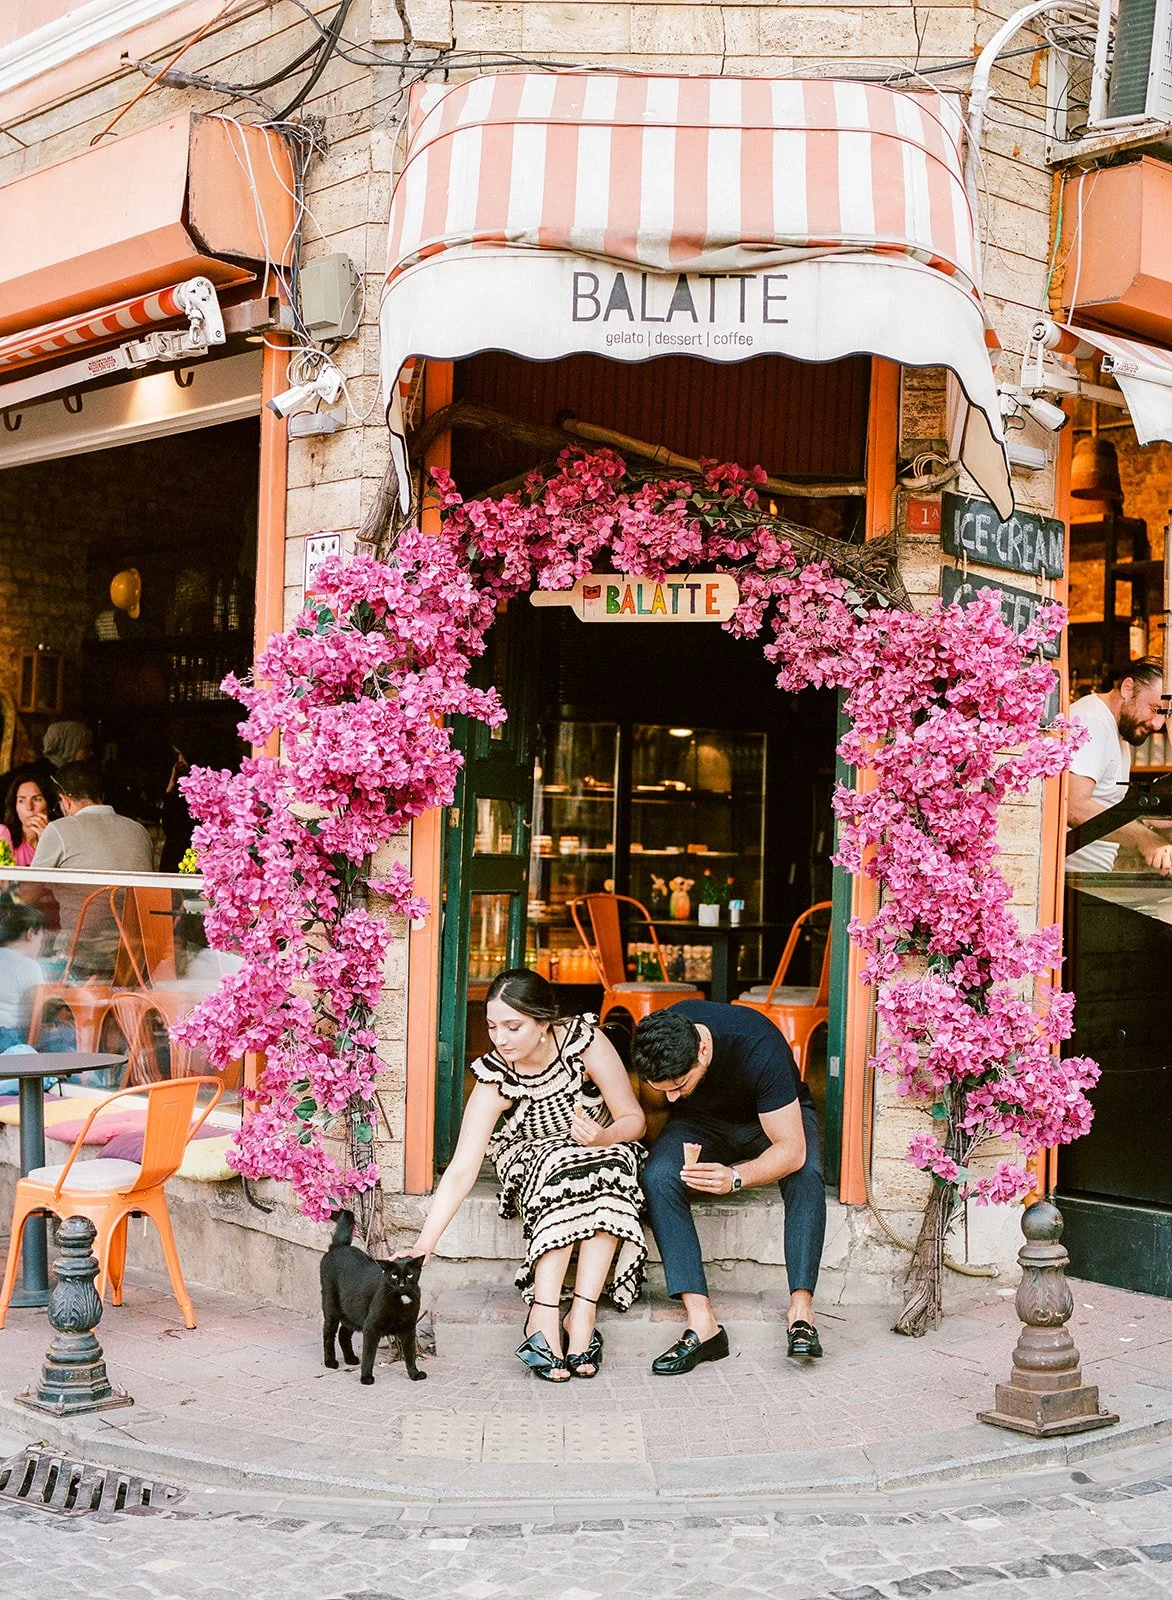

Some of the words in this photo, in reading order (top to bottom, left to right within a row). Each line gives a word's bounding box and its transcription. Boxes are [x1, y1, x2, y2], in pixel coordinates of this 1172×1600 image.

[572, 271, 789, 323] BALATTE
[606, 331, 644, 346] gelato
[655, 332, 702, 346] dessert
[713, 332, 753, 346] coffee
[606, 583, 720, 615] BALATTE
